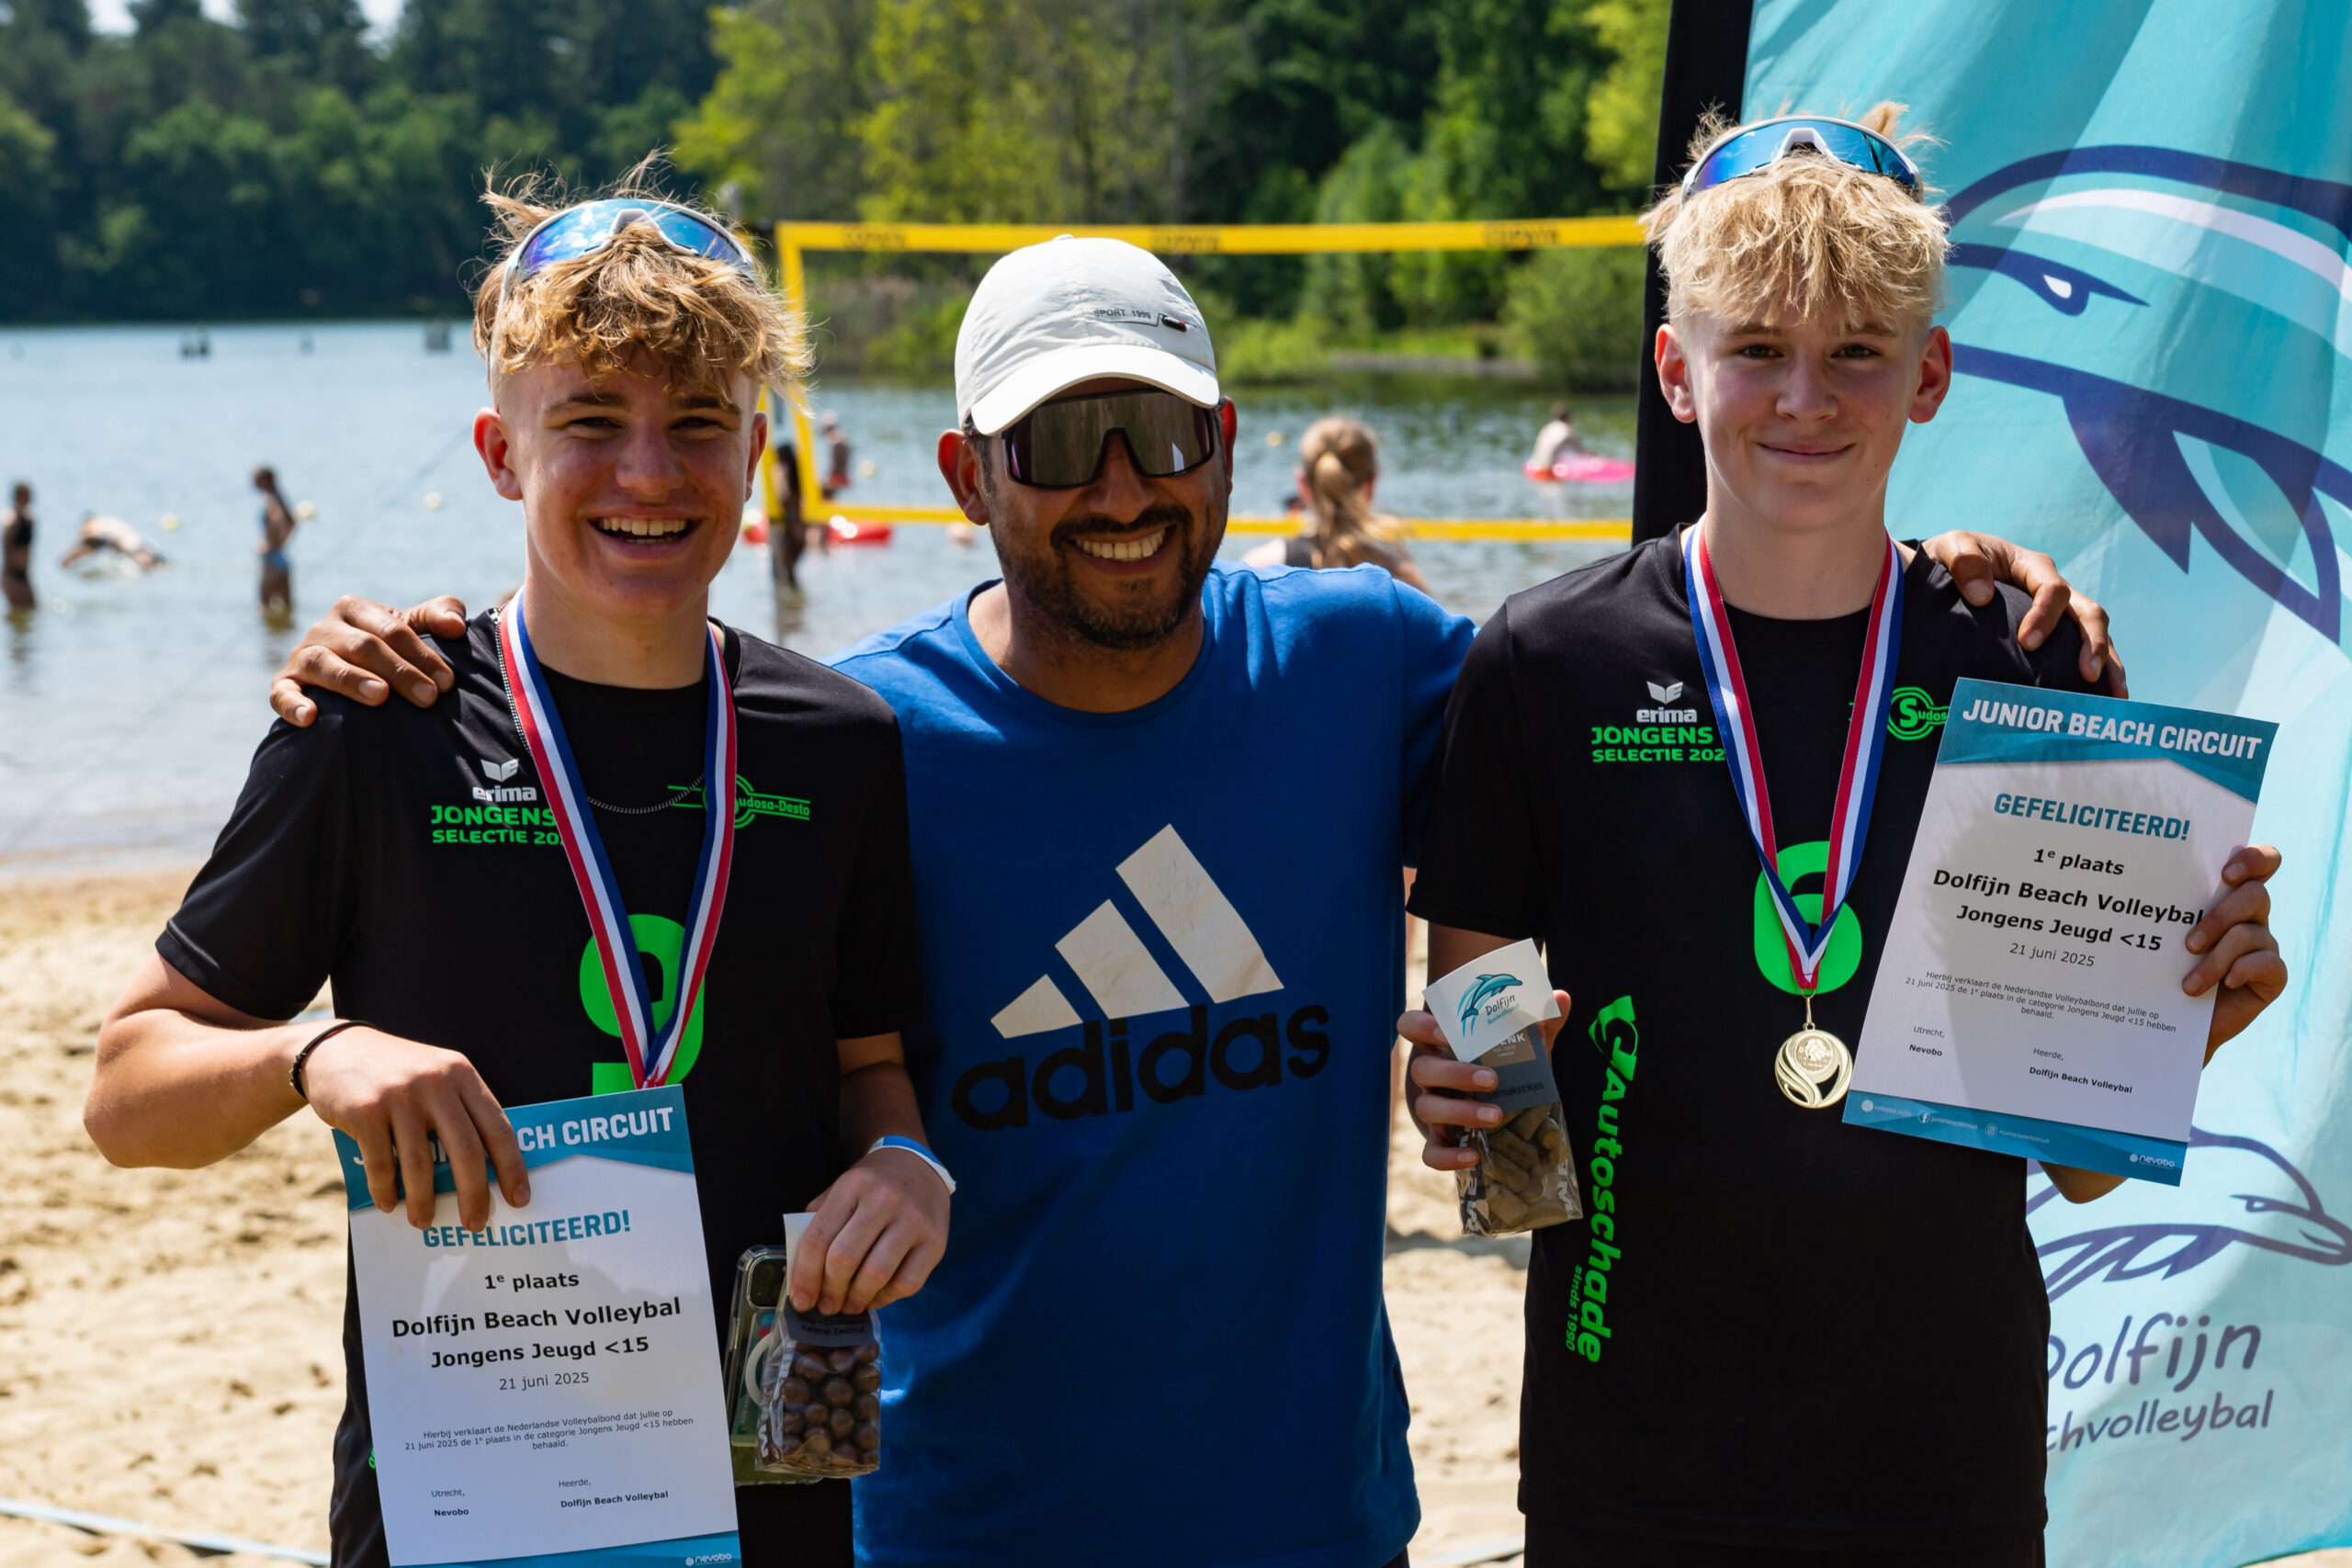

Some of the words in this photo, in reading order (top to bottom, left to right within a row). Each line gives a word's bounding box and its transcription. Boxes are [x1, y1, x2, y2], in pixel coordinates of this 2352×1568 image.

[1093, 309, 1125, 317] SPORT
[1636, 706, 1698, 723] erima
[1899, 697, 1947, 728] Sudos
[1591, 727, 1713, 745] JONGENS
[1962, 699, 2064, 733] JUNIOR
[2067, 713, 2154, 747] BEACH
[2159, 726, 2262, 760] CIRCUIT
[1592, 749, 1684, 762] SELECTIE
[1689, 749, 1726, 761] 202
[472, 785, 537, 802] erima
[430, 806, 557, 827] JONGENS
[735, 796, 810, 816] udosa-Desto
[1994, 793, 2190, 840] GEFELICITEERD!
[432, 829, 528, 844] SELECTIE
[533, 830, 564, 845] 20
[2059, 853, 2124, 875] plaats
[1932, 869, 2011, 897] Dolfijn
[2018, 882, 2088, 908] Beach
[2097, 893, 2204, 926] Volleybal
[1753, 840, 1862, 995] 6
[1956, 905, 2044, 931] Jongens
[2049, 919, 2112, 944] Jeugd
[2120, 933, 2163, 952] <15
[2009, 942, 2026, 955] 21
[2030, 946, 2057, 961] juni
[2061, 951, 2096, 967] 2025
[1905, 976, 1916, 986] 21
[1917, 980, 1933, 988] juni
[1935, 982, 1955, 992] 2025
[1957, 986, 1968, 995] de
[1980, 989, 2005, 1000] plaats
[2016, 996, 2027, 1004] de
[2029, 998, 2064, 1010] categorie
[2066, 1005, 2099, 1018] Jongens
[2101, 1012, 2125, 1023] Jeugd
[2128, 1018, 2143, 1026] <15
[2146, 1021, 2177, 1032] hebben
[1926, 971, 1952, 983] Hierbij
[1954, 976, 1989, 988] verklaart
[1992, 982, 2002, 990] de
[2004, 984, 2052, 999] Nederlandse
[2055, 992, 2110, 1010] Volleybalbond
[2112, 1004, 2125, 1013] dat
[2127, 1007, 2147, 1017] jullie
[1485, 995, 1515, 1016] Dolfijn
[2021, 1006, 2054, 1019] behaald.
[1913, 1025, 1945, 1038] Utrecht,
[1909, 1043, 1942, 1056] Nevobo
[2033, 1047, 2064, 1061] Heerde,
[951, 1003, 1330, 1132] adidas
[2030, 1066, 2059, 1079] Dolfijn
[2061, 1073, 2088, 1085] Beach
[2091, 1078, 2133, 1093] Volleybal
[561, 1107, 673, 1146] CIRCUIT
[2139, 1155, 2176, 1168] nevobo
[1577, 1066, 1626, 1362] Autoschade
[423, 1210, 630, 1247] GEFELICITEERD!
[512, 1272, 580, 1292] plaats
[1569, 1265, 1582, 1309] sinds
[392, 1314, 475, 1337] Dolfijn
[484, 1309, 558, 1329] Beach
[565, 1296, 681, 1326] Volleybal
[1566, 1313, 1578, 1351] 1990
[431, 1345, 525, 1369] Jongens
[531, 1340, 596, 1361] Jeugd
[605, 1336, 649, 1355] <15
[499, 1378, 516, 1391] 21
[521, 1374, 549, 1391] juni
[554, 1371, 590, 1386] 2025
[423, 1430, 452, 1439] Hierbij
[454, 1426, 492, 1437] verklaart
[494, 1425, 505, 1434] de
[507, 1419, 560, 1432] Nederlandse
[562, 1413, 621, 1427] Volleybalbond
[623, 1412, 638, 1421] dat
[639, 1410, 660, 1420] jullie
[662, 1409, 673, 1418] op
[2046, 1389, 2274, 1451] chvolleybal
[404, 1442, 415, 1450] 21
[418, 1440, 435, 1451] juni
[436, 1438, 458, 1449] 2025
[460, 1438, 471, 1446] de
[485, 1434, 511, 1445] plaats
[514, 1433, 522, 1441] in
[524, 1432, 535, 1440] de
[537, 1427, 576, 1439] categorie
[579, 1425, 613, 1435] Jongens
[615, 1422, 639, 1432] Jeugd
[662, 1417, 694, 1427] hebben
[532, 1439, 569, 1450] behaald.
[431, 1487, 465, 1498] Utrecht,
[559, 1477, 592, 1488] Heerde,
[560, 1498, 592, 1508] Dolfijn
[594, 1495, 623, 1505] Beach
[625, 1490, 669, 1503] Volleybal
[434, 1507, 469, 1517] Nevobo
[695, 1552, 732, 1562] nevobo
